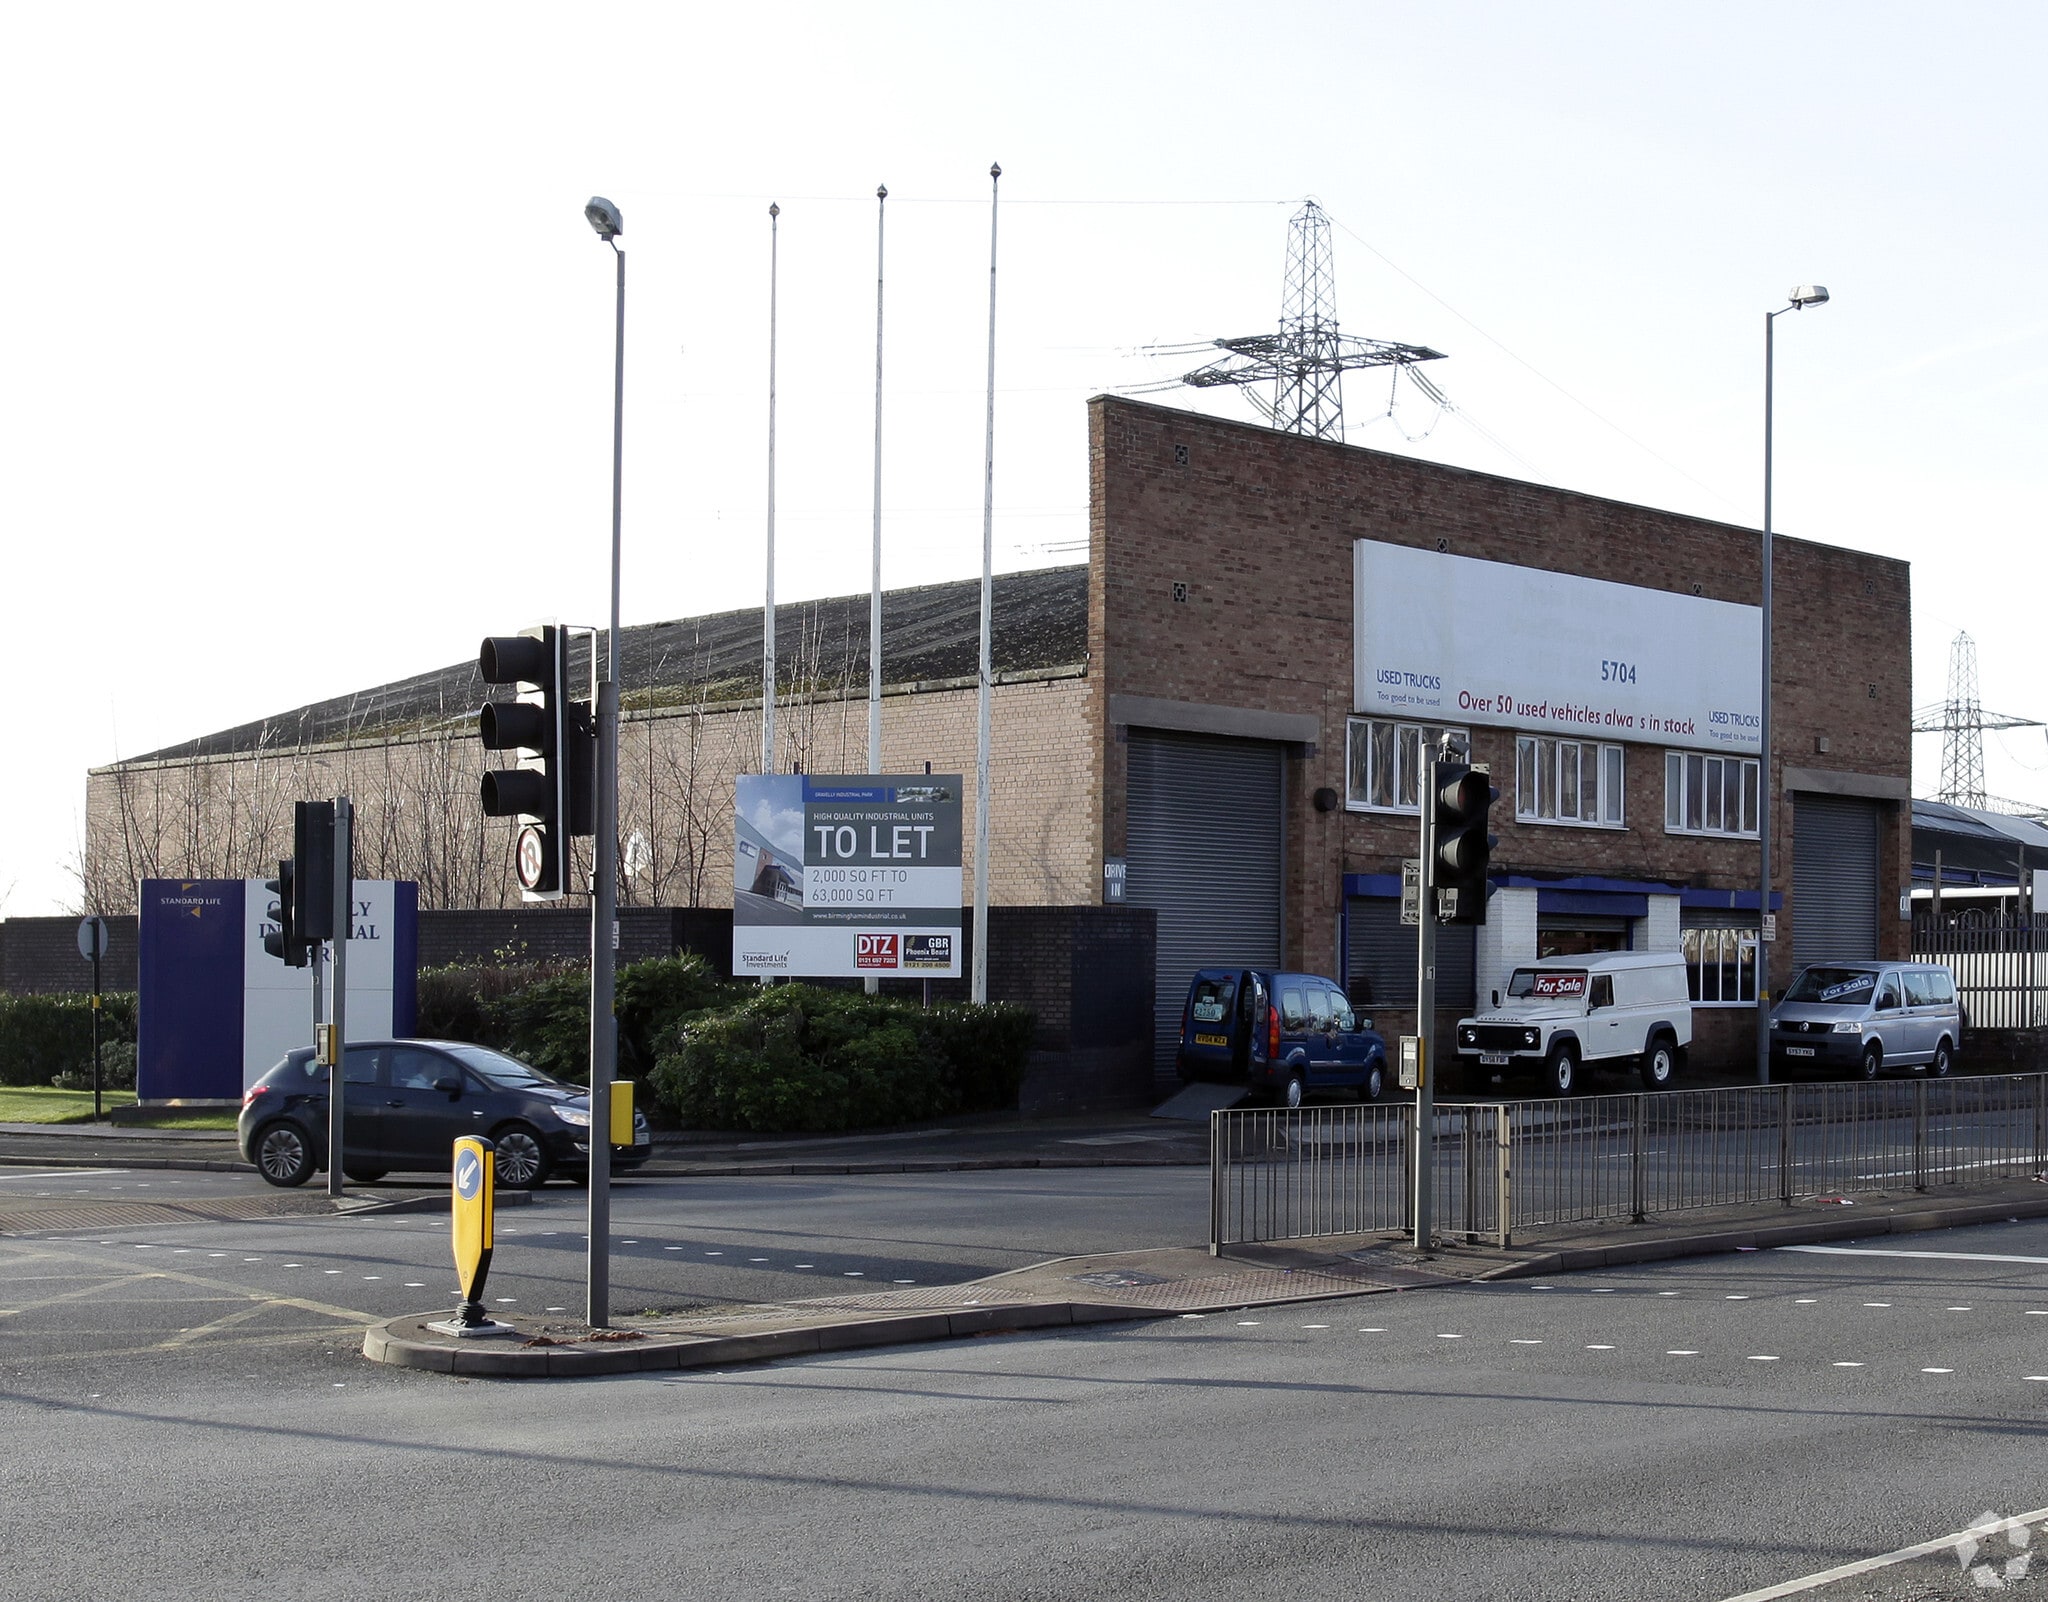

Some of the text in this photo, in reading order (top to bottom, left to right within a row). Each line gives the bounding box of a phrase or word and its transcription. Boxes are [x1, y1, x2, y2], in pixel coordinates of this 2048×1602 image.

[1377, 669, 1441, 690] USED TRUCKS
[1601, 660, 1637, 684] 5704
[1377, 691, 1441, 707] Too good to be used
[1458, 690, 1492, 712] Over
[1497, 695, 1513, 714] 50
[1517, 701, 1547, 718] used
[1551, 702, 1601, 725] vehicles
[1649, 714, 1660, 731] in
[1664, 717, 1696, 735] stock
[1709, 710, 1760, 728] USED TRUCKS
[1709, 729, 1760, 742] Too good to be used
[813, 812, 934, 821] HIGH QUALITY INDUSTRIAL UNITS
[814, 825, 935, 858] TO LET
[812, 869, 908, 884] 2,000 SQ FT TO
[1105, 864, 1127, 879] DRIVE
[812, 888, 895, 903] 63,000 SQ FT
[1111, 882, 1121, 897] IN
[858, 935, 893, 954] DTZ
[928, 937, 949, 948] GBR
[742, 954, 788, 962] Standard Life
[746, 961, 787, 969] Investments
[1537, 978, 1582, 993] For Sale
[1822, 977, 1870, 998] For Sale
